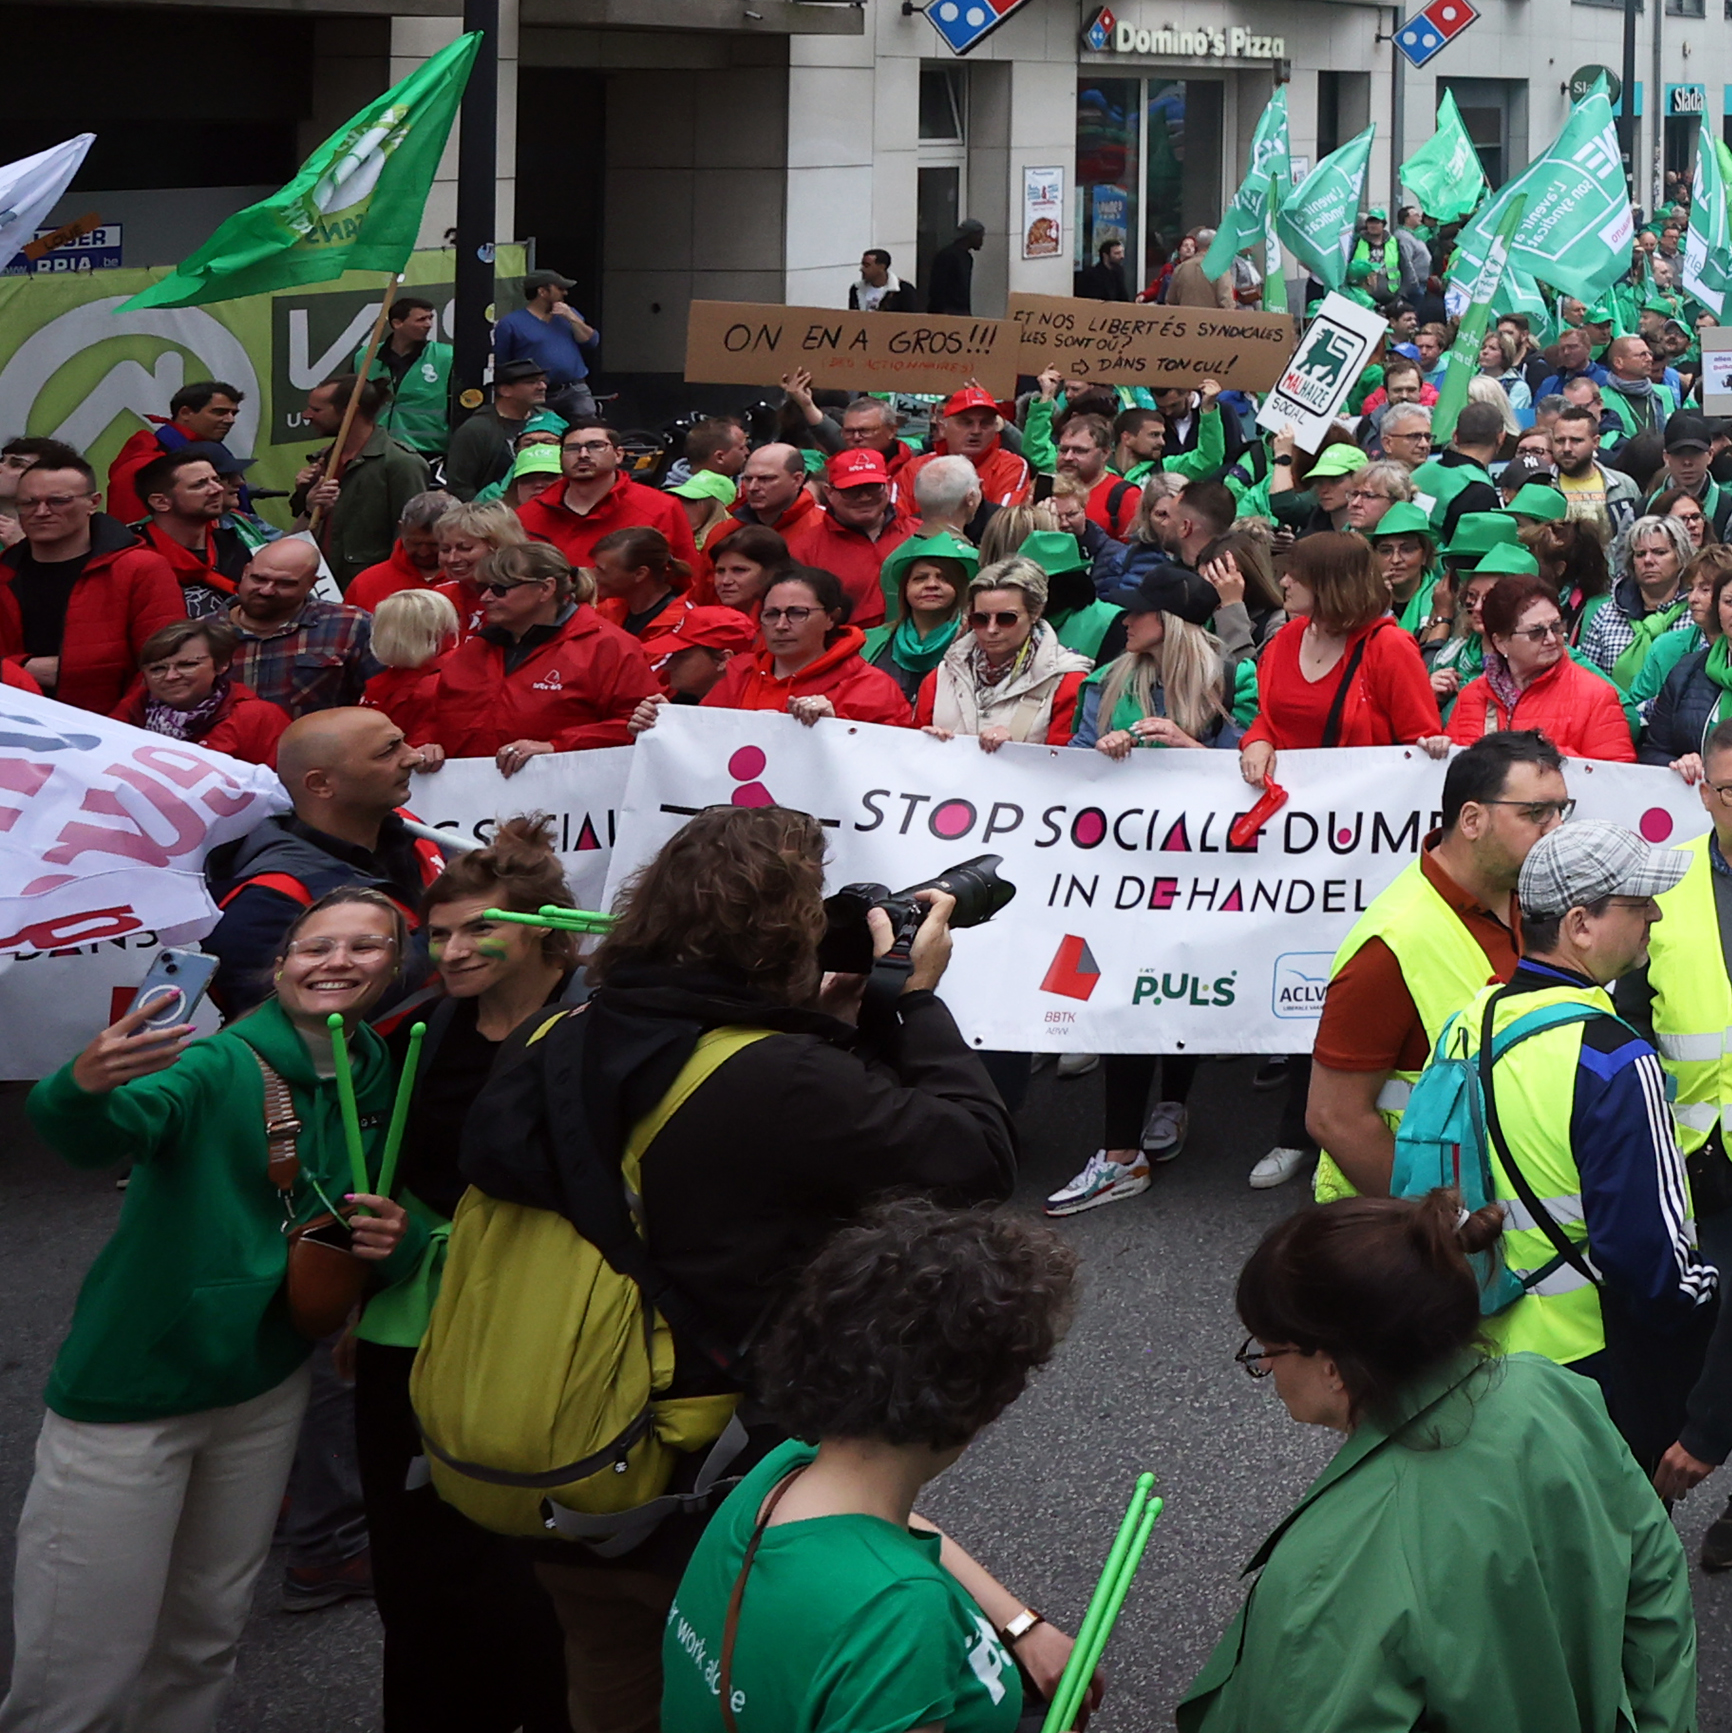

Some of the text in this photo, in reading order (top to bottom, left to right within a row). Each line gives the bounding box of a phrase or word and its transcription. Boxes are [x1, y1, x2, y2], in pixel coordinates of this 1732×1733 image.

[1115, 19, 1285, 58] Domino's Pizza
[724, 323, 998, 355] ON EN A GROS!!!
[1040, 312, 1075, 329] NOS
[1089, 315, 1187, 337] LIBERTÉS
[1197, 321, 1284, 343] SYNDICALES
[1054, 333, 1092, 350] SONT
[1157, 358, 1191, 373] TON
[1193, 354, 1239, 375] CUL!
[1281, 370, 1331, 410] MALHAIZE
[1272, 396, 1304, 426] SOCIAL
[855, 789, 1024, 844] STOP
[1034, 804, 1264, 852] SOCIALE
[1047, 873, 1099, 908] IN
[1187, 878, 1368, 913] HANDEL
[1279, 986, 1327, 1003] ACLV
[1044, 1011, 1077, 1024] BBTK
[677, 1617, 708, 1670] work
